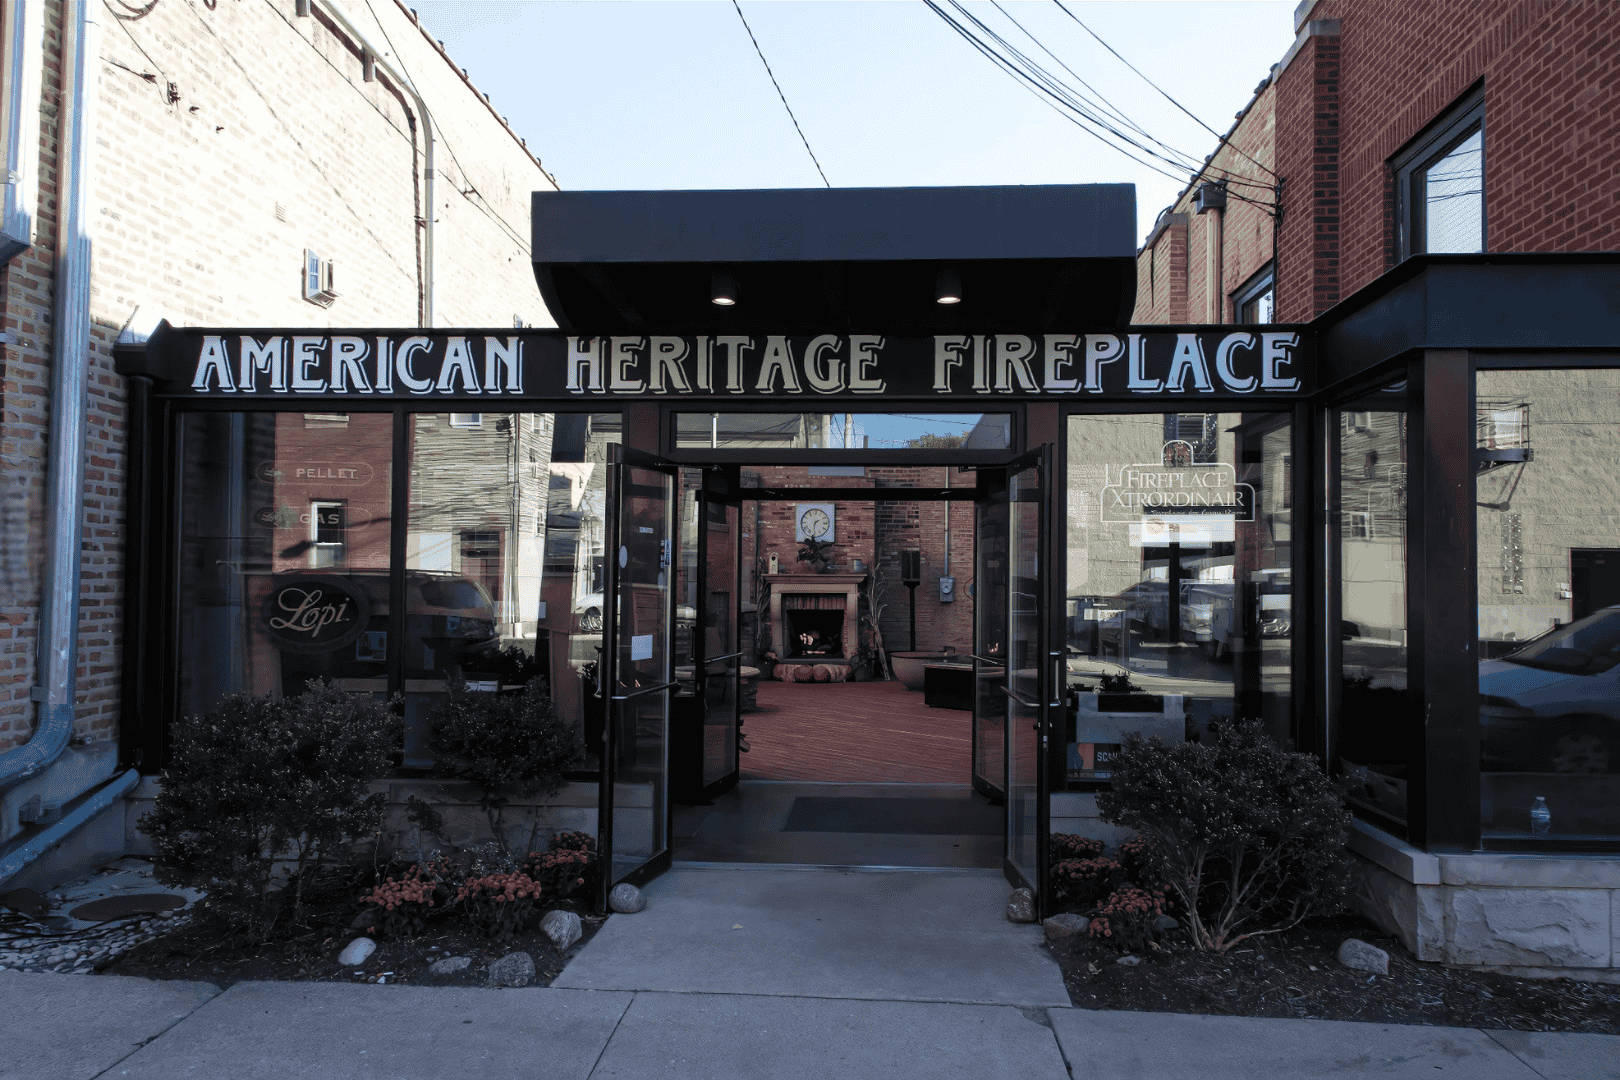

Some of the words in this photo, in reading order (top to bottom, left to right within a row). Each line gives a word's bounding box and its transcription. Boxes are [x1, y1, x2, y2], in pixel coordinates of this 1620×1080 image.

[191, 335, 525, 394] AMERICAN
[566, 334, 886, 394] HERITAGE
[932, 332, 1301, 394] FIREPLACE
[296, 468, 358, 479] PELLET
[1126, 470, 1228, 488] FIREPLACE
[1111, 489, 1245, 508] XTRORDINAIR
[299, 513, 340, 525] GAS
[269, 589, 350, 638] Lopi
